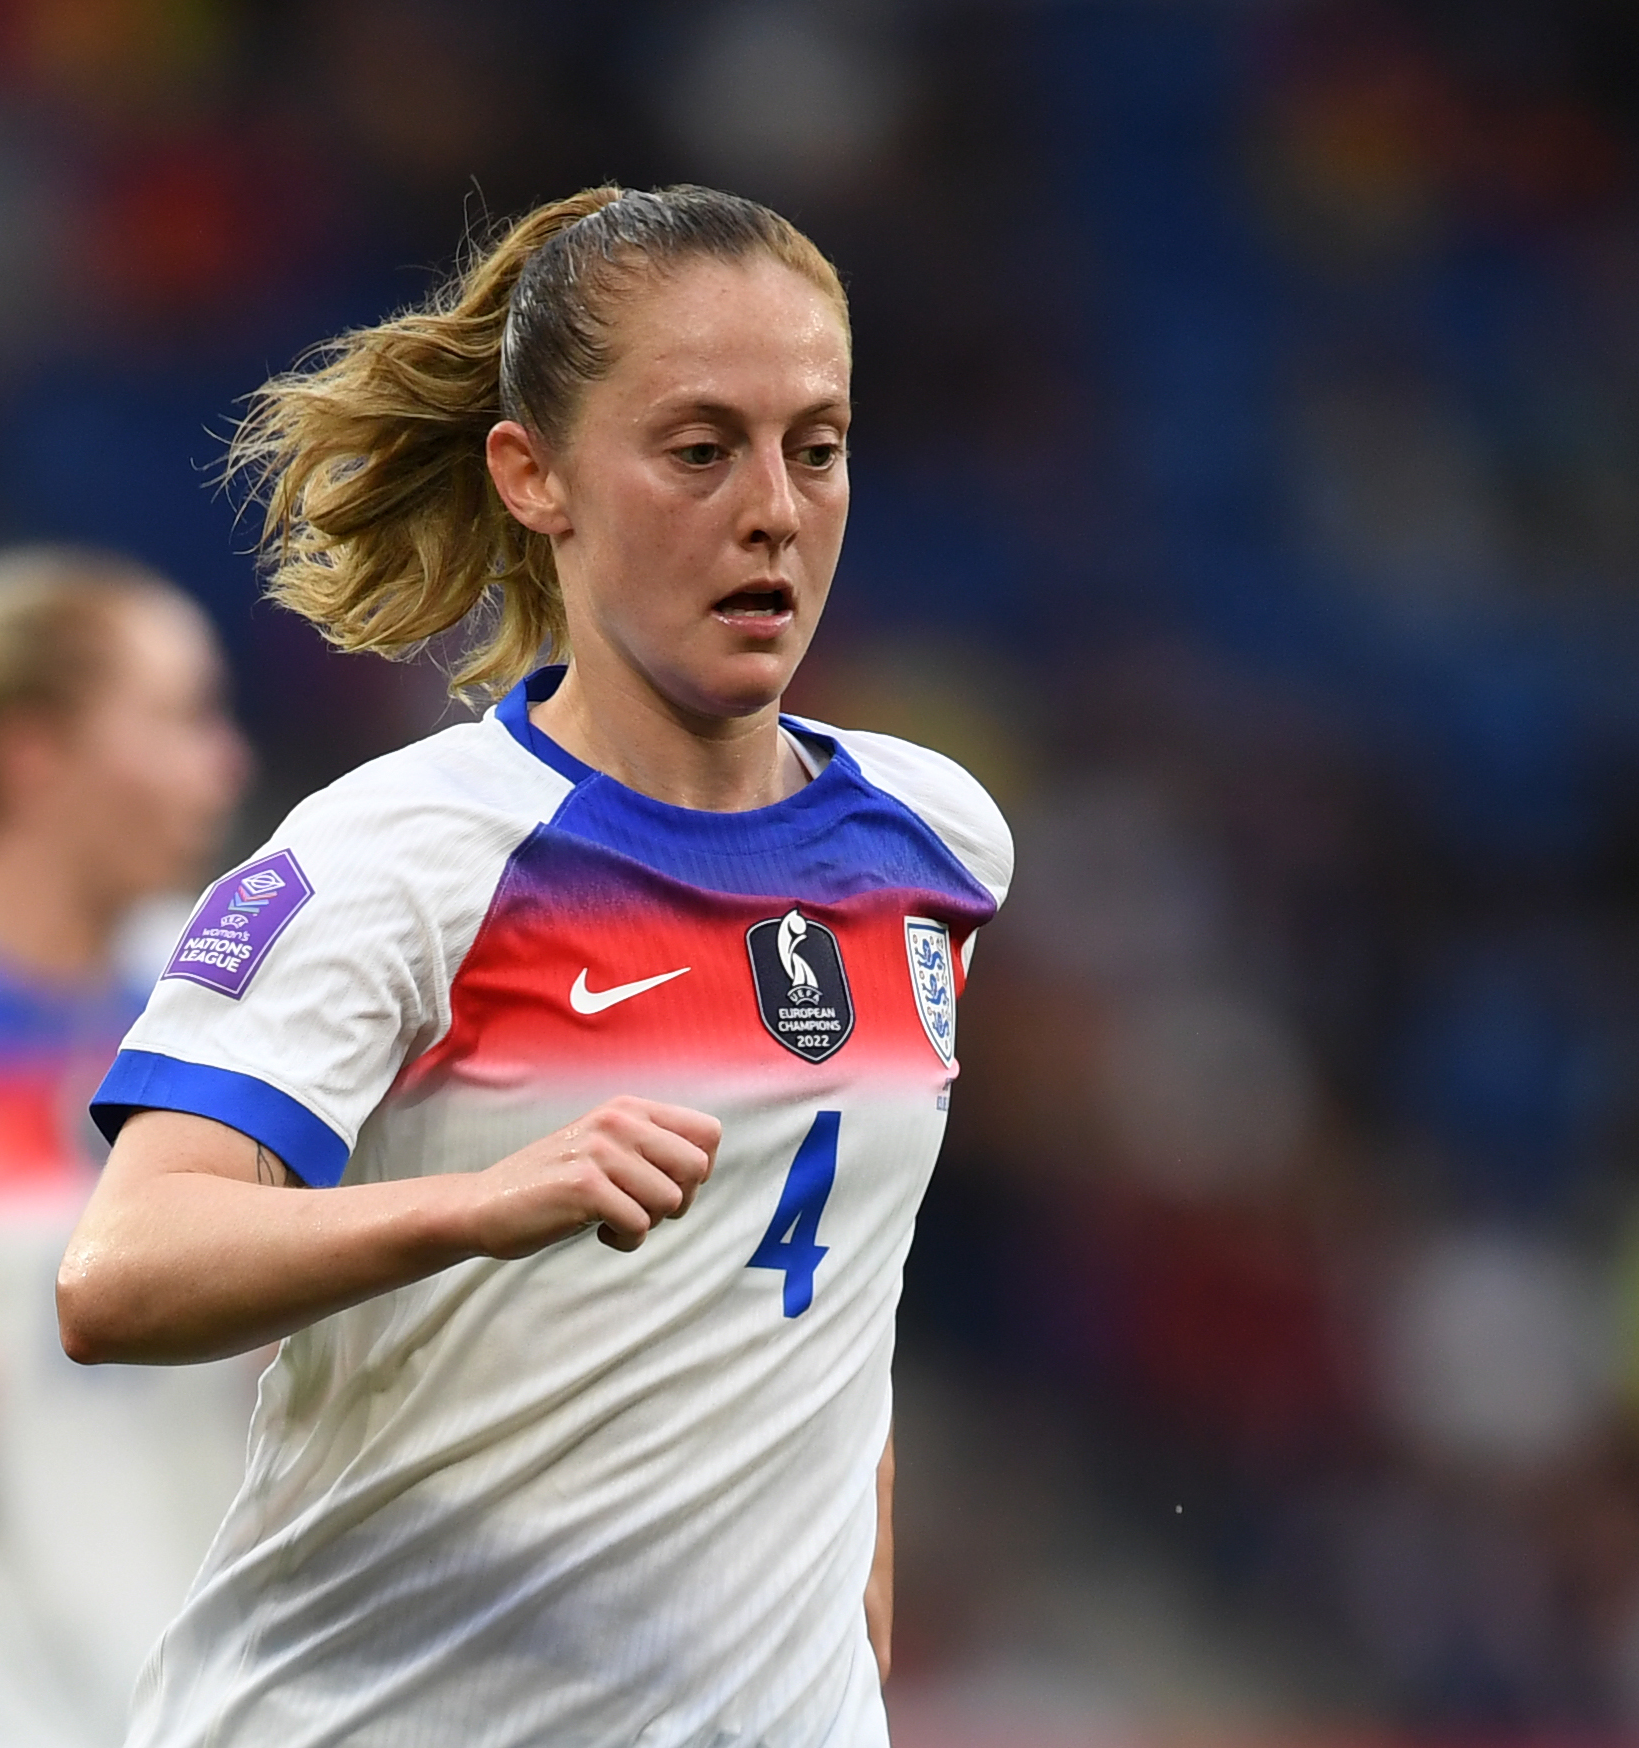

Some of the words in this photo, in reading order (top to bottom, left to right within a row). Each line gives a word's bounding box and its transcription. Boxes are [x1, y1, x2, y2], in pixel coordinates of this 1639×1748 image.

[185, 938, 252, 959] NATIONS
[180, 950, 242, 973] LEAGUE
[789, 988, 820, 1003] UEFA
[778, 1007, 836, 1019] EUROPEAN
[778, 1020, 841, 1032] CHAMPIONS
[796, 1034, 830, 1048] 2022
[745, 1111, 842, 1318] 4
